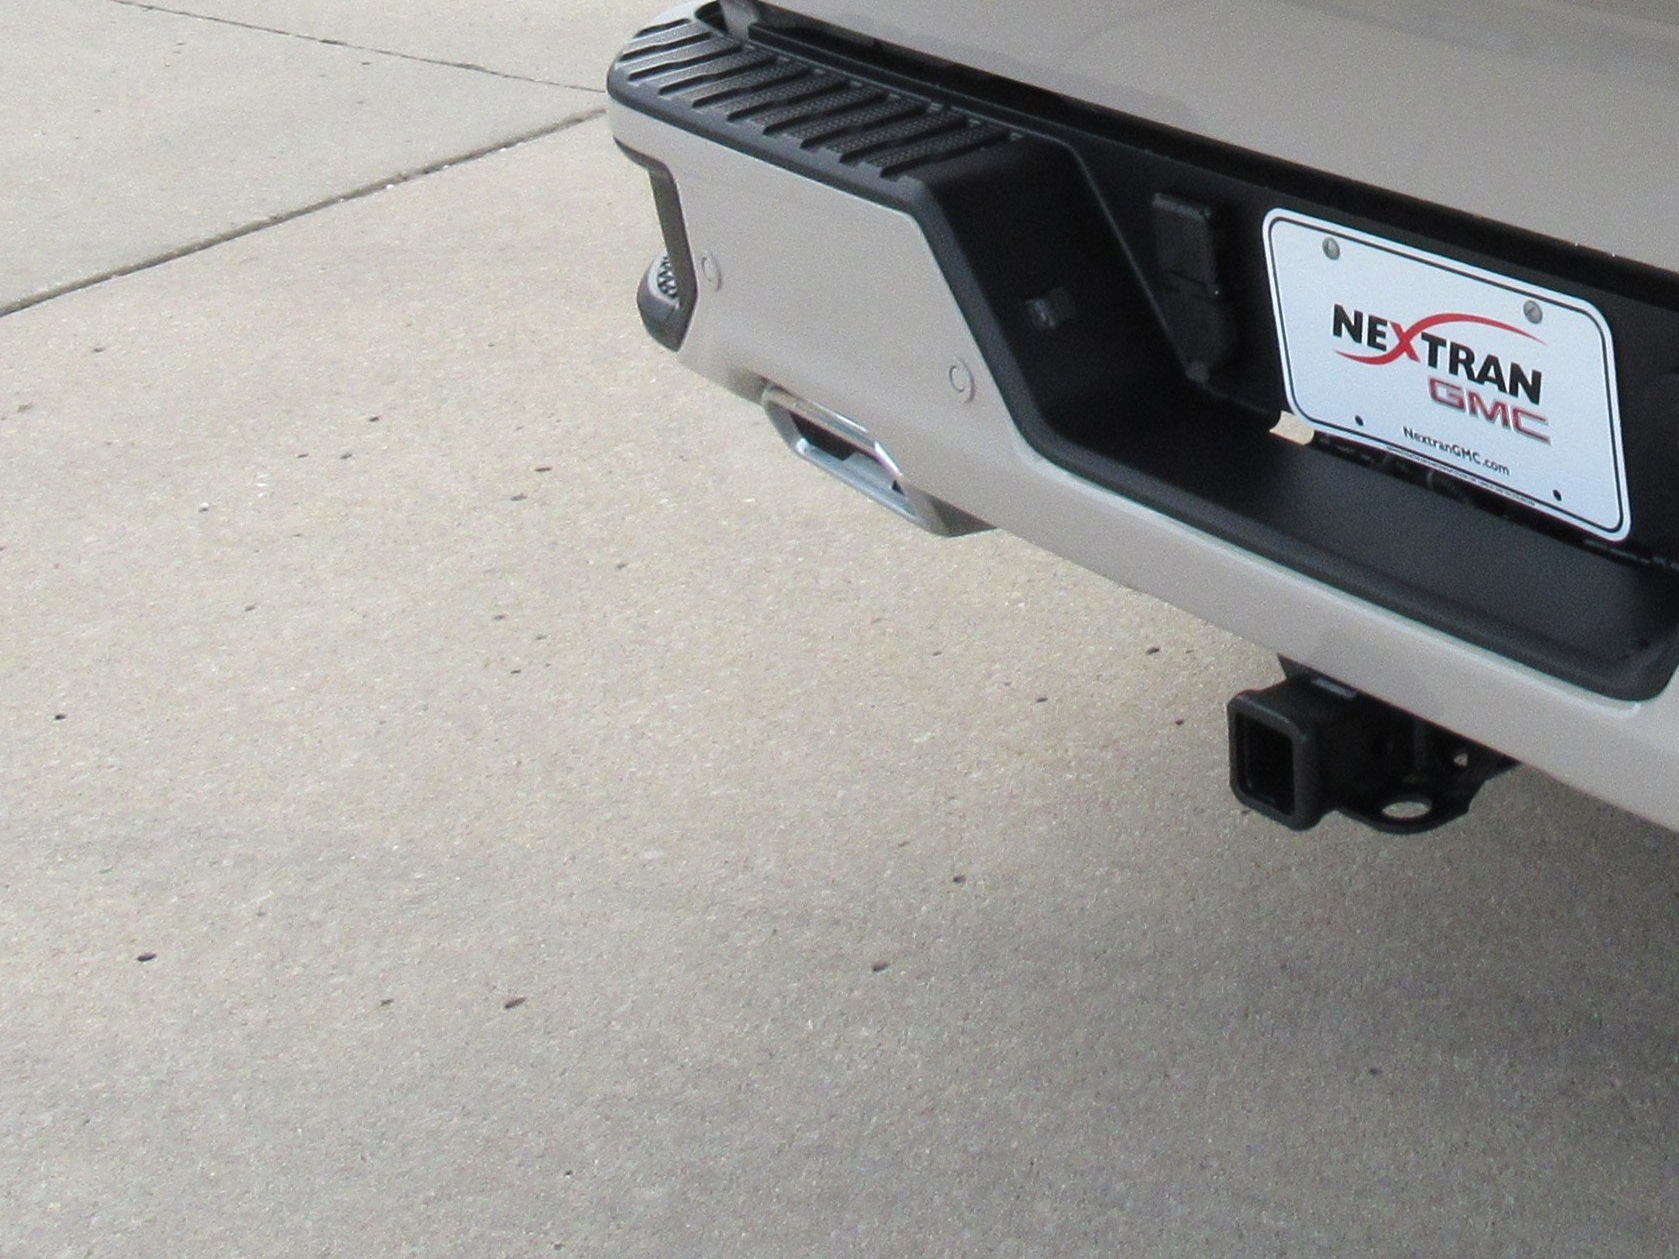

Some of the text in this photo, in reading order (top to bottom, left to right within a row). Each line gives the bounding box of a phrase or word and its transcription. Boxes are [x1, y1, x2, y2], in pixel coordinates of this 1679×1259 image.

[1332, 304, 1543, 405] NEXTRAN
[1428, 376, 1551, 445] GMC
[1402, 426, 1510, 475] NextranGMC.com
